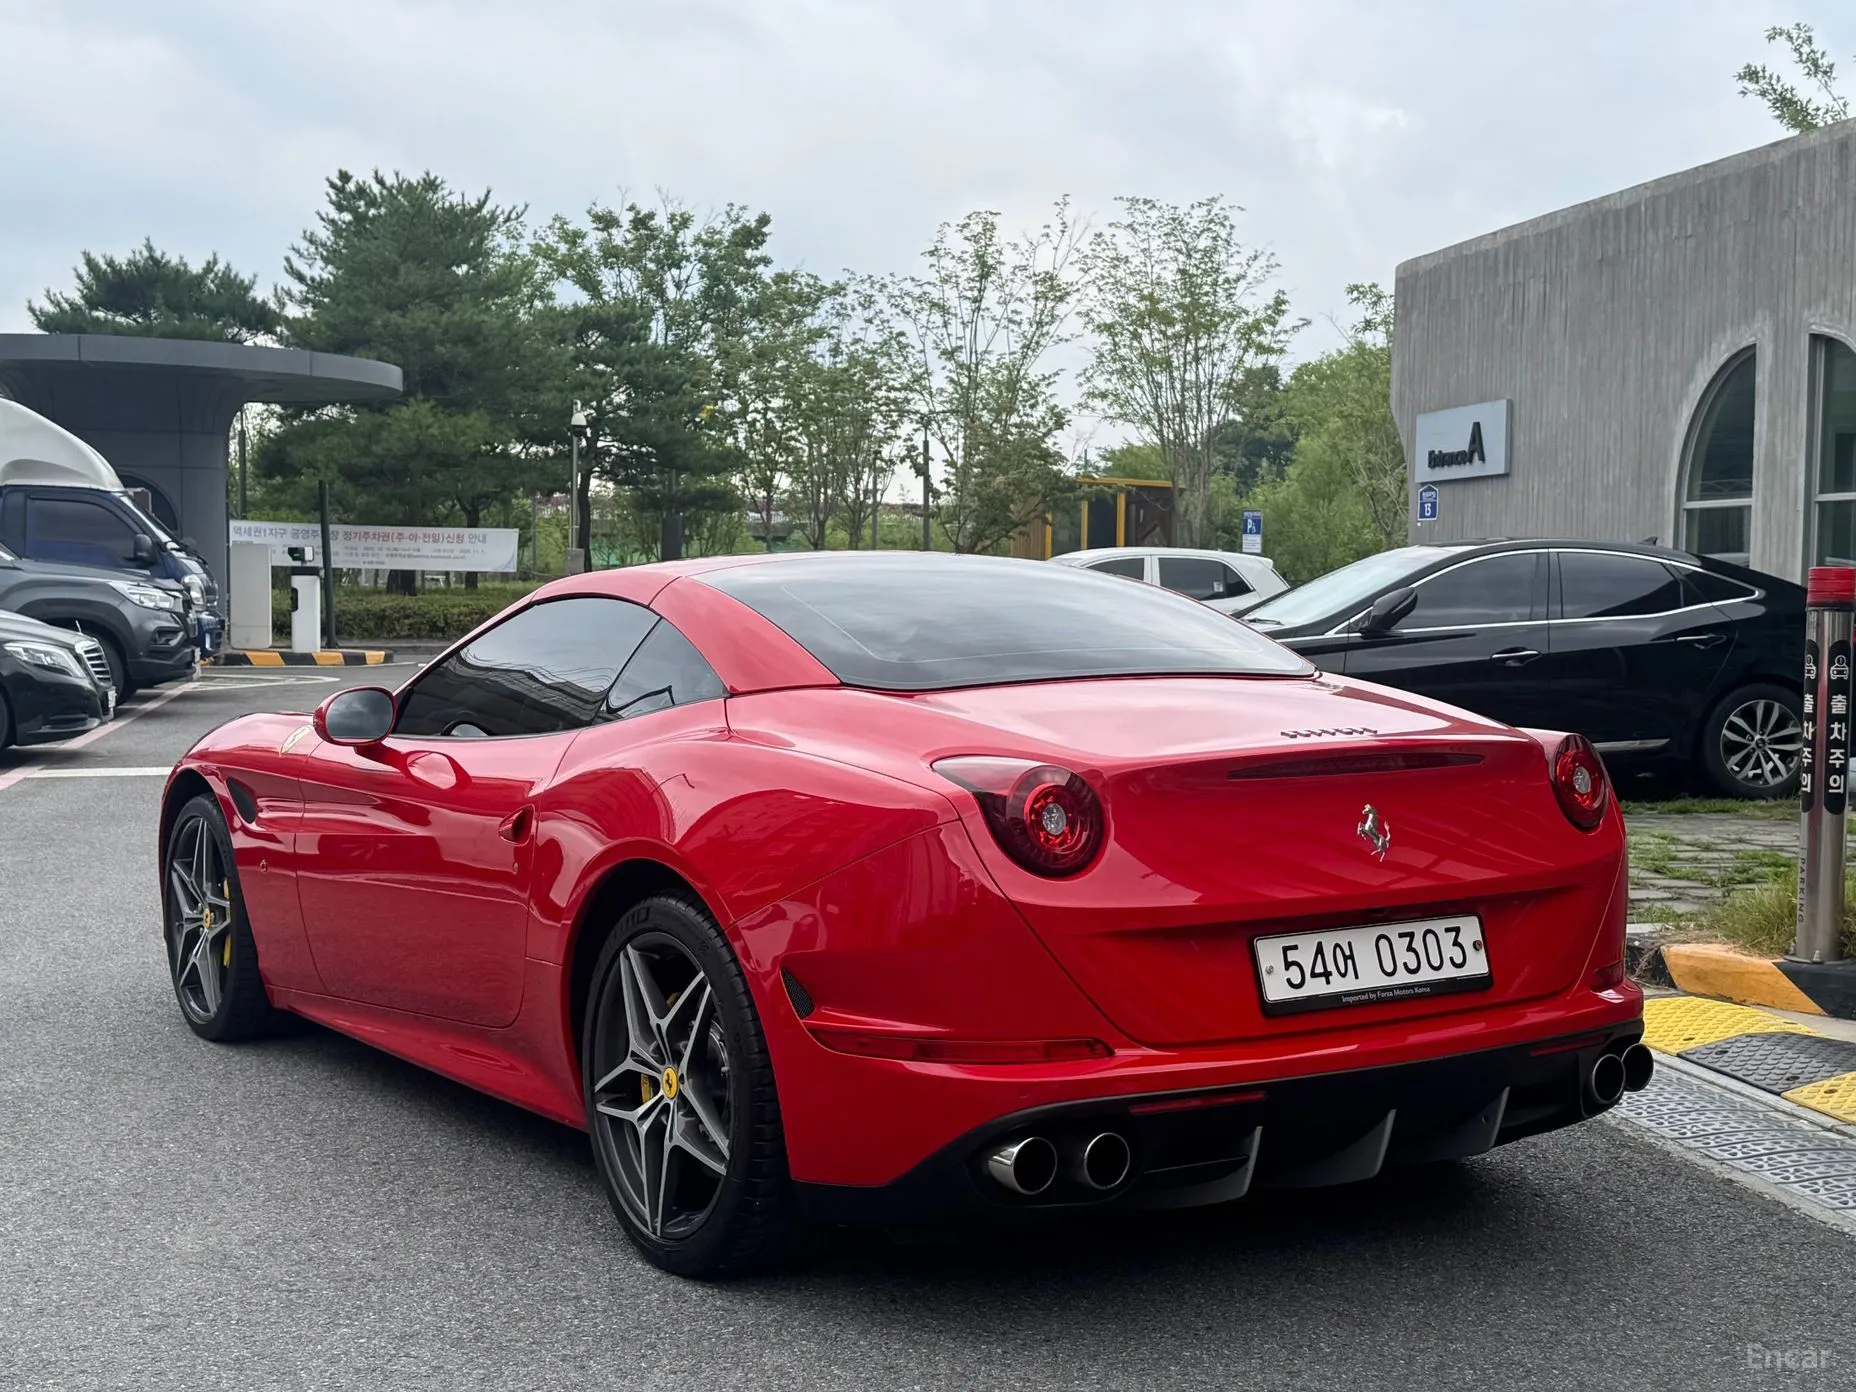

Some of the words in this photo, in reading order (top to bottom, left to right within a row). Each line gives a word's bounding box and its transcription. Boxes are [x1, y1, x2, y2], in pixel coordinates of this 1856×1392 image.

[1467, 421, 1486, 464] A
[290, 527, 340, 541] 공영주장
[468, 532, 487, 544] 안내
[1247, 518, 1253, 534] P
[1828, 694, 1847, 794] 출차주의
[1281, 940, 1359, 989] 54어
[1375, 925, 1467, 977] 0303
[1342, 993, 1369, 1003] Imported
[1369, 992, 1377, 1000] by
[1377, 990, 1393, 998] Forza
[1393, 988, 1414, 996] Motors
[1414, 985, 1431, 993] Korea
